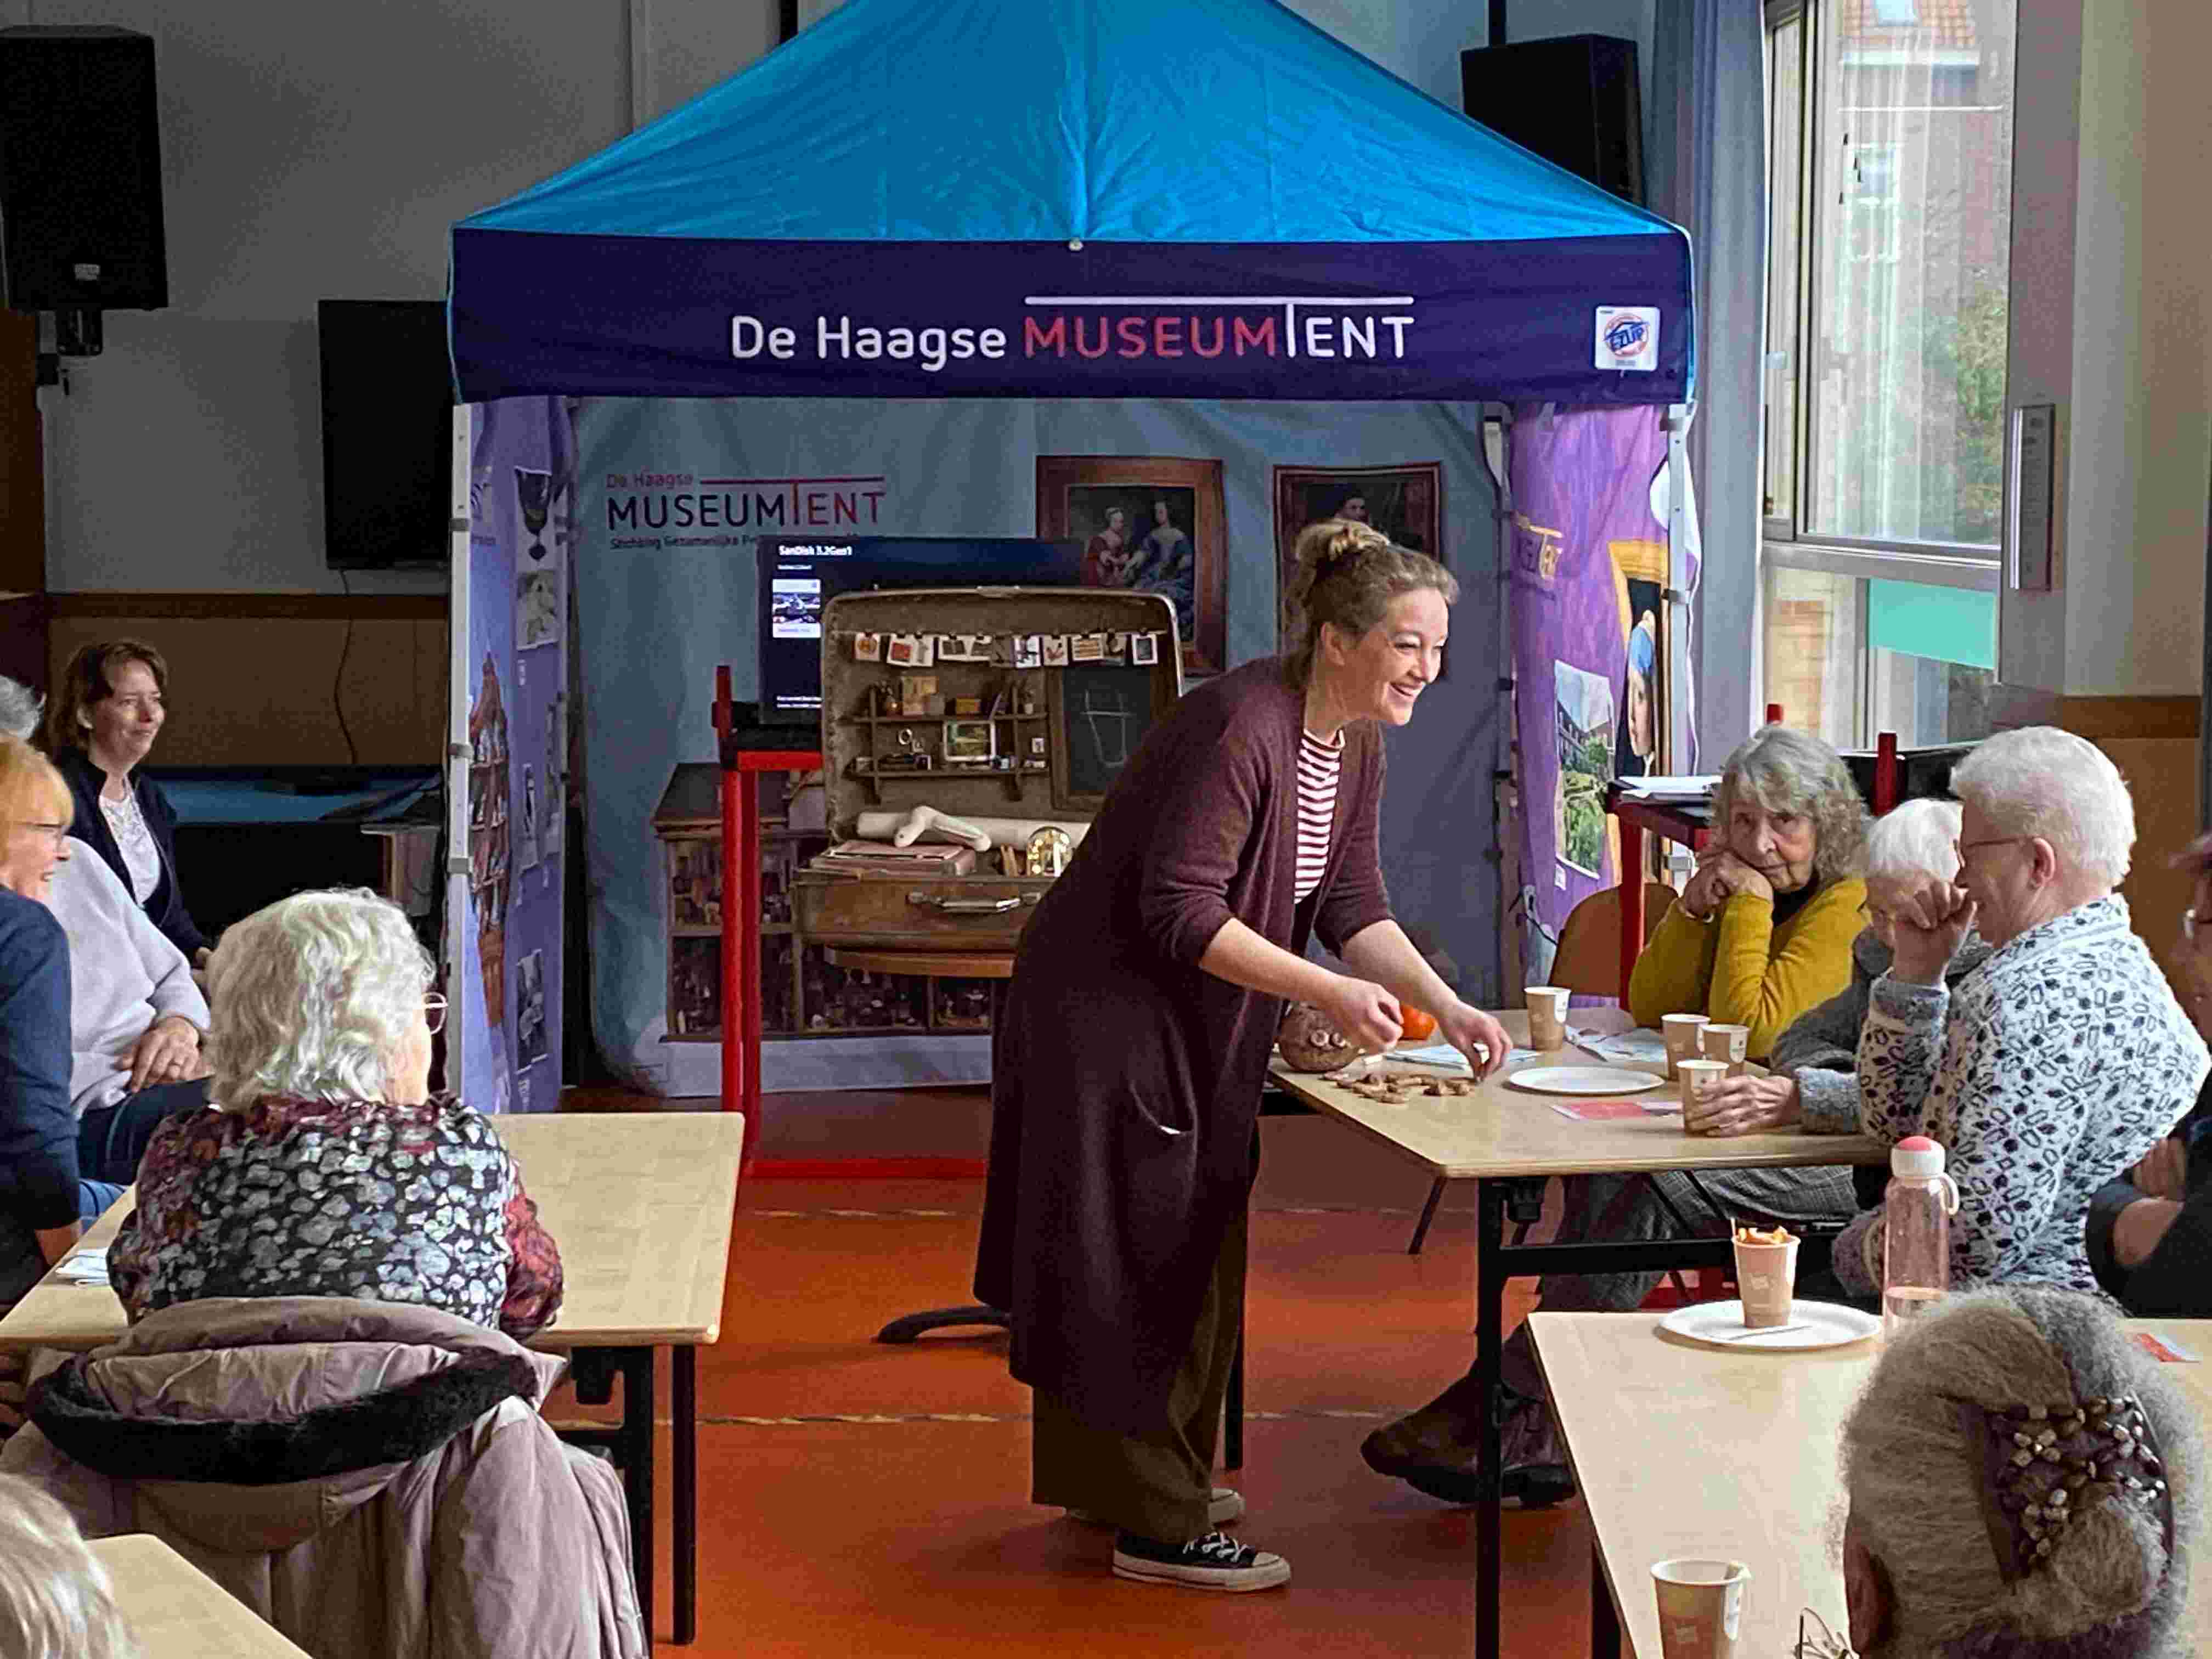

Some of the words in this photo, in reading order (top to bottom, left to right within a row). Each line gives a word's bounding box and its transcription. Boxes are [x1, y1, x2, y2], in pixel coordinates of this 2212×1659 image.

[731, 315, 796, 358] De
[817, 315, 1007, 371] Haagse
[1024, 297, 1414, 358] MUSEUMTENT
[606, 473, 627, 488] De
[632, 473, 693, 490] Haagse
[607, 476, 886, 531] MUSEUMTENT
